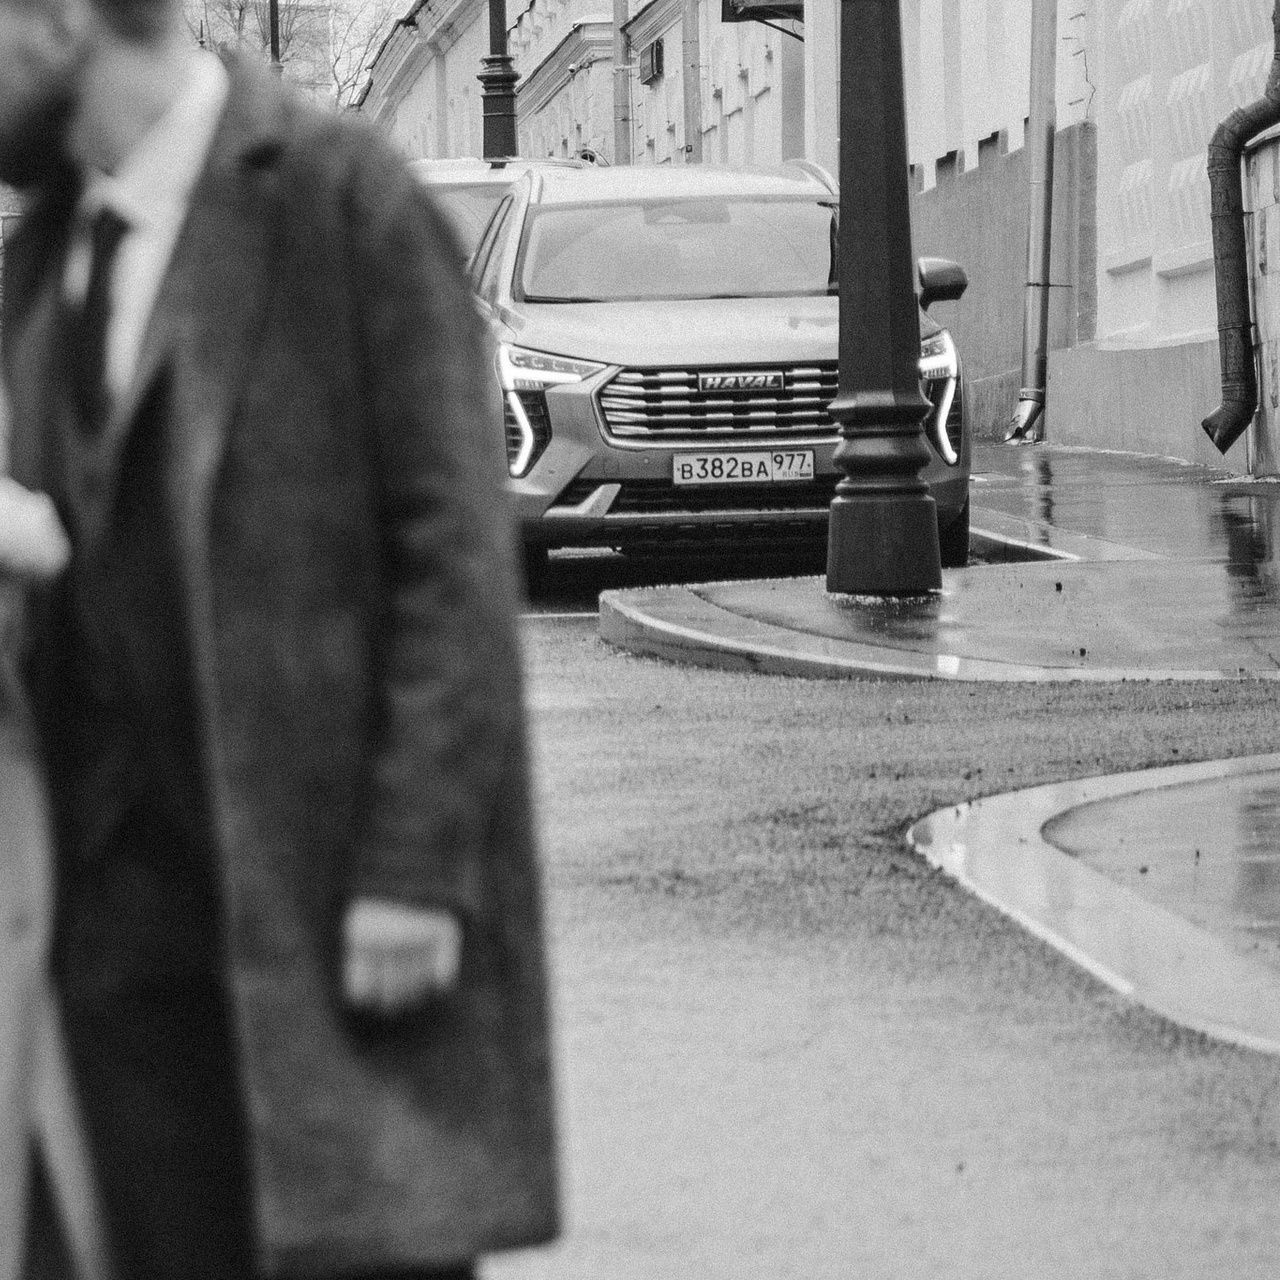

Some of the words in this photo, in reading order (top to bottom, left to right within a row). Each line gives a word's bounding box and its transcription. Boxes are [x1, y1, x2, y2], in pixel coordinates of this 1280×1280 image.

[705, 375, 779, 388] HAVAL
[682, 457, 768, 479] В382ВА
[774, 453, 806, 470] 977
